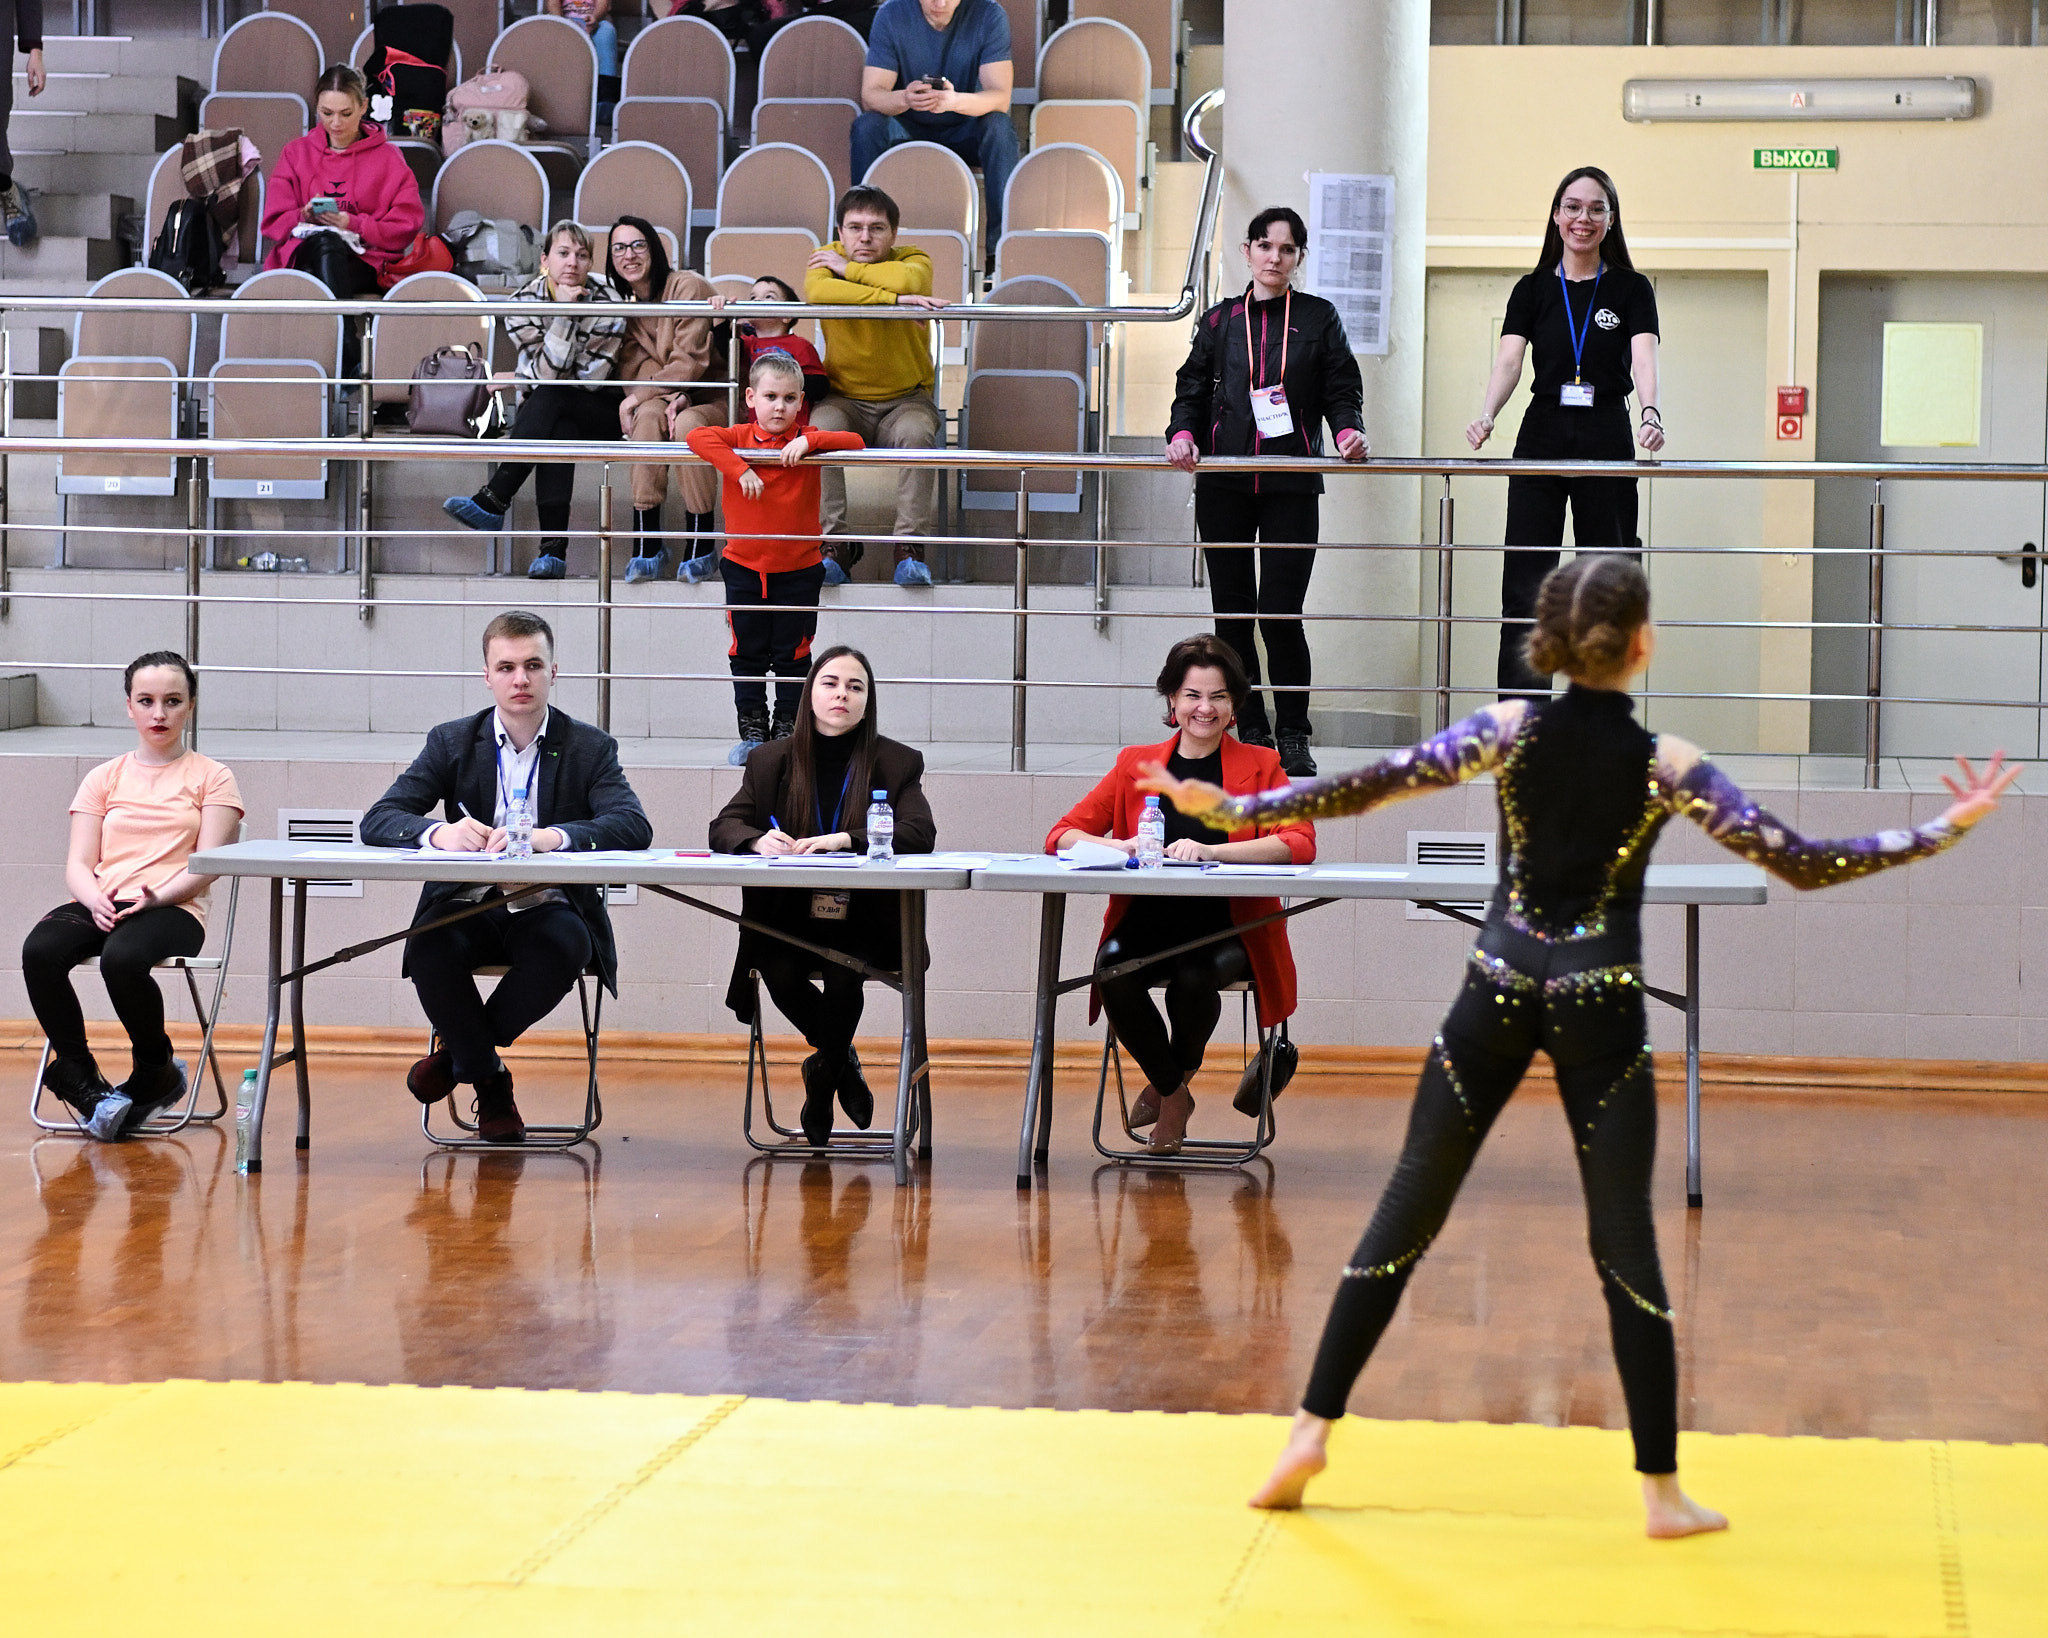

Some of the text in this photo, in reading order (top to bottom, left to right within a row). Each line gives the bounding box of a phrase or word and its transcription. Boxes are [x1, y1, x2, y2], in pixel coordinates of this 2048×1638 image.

[1760, 150, 1829, 168] ВЫХОД
[107, 480, 119, 488] 20
[260, 484, 271, 492] 21
[817, 905, 842, 914] СУДЬЯ
